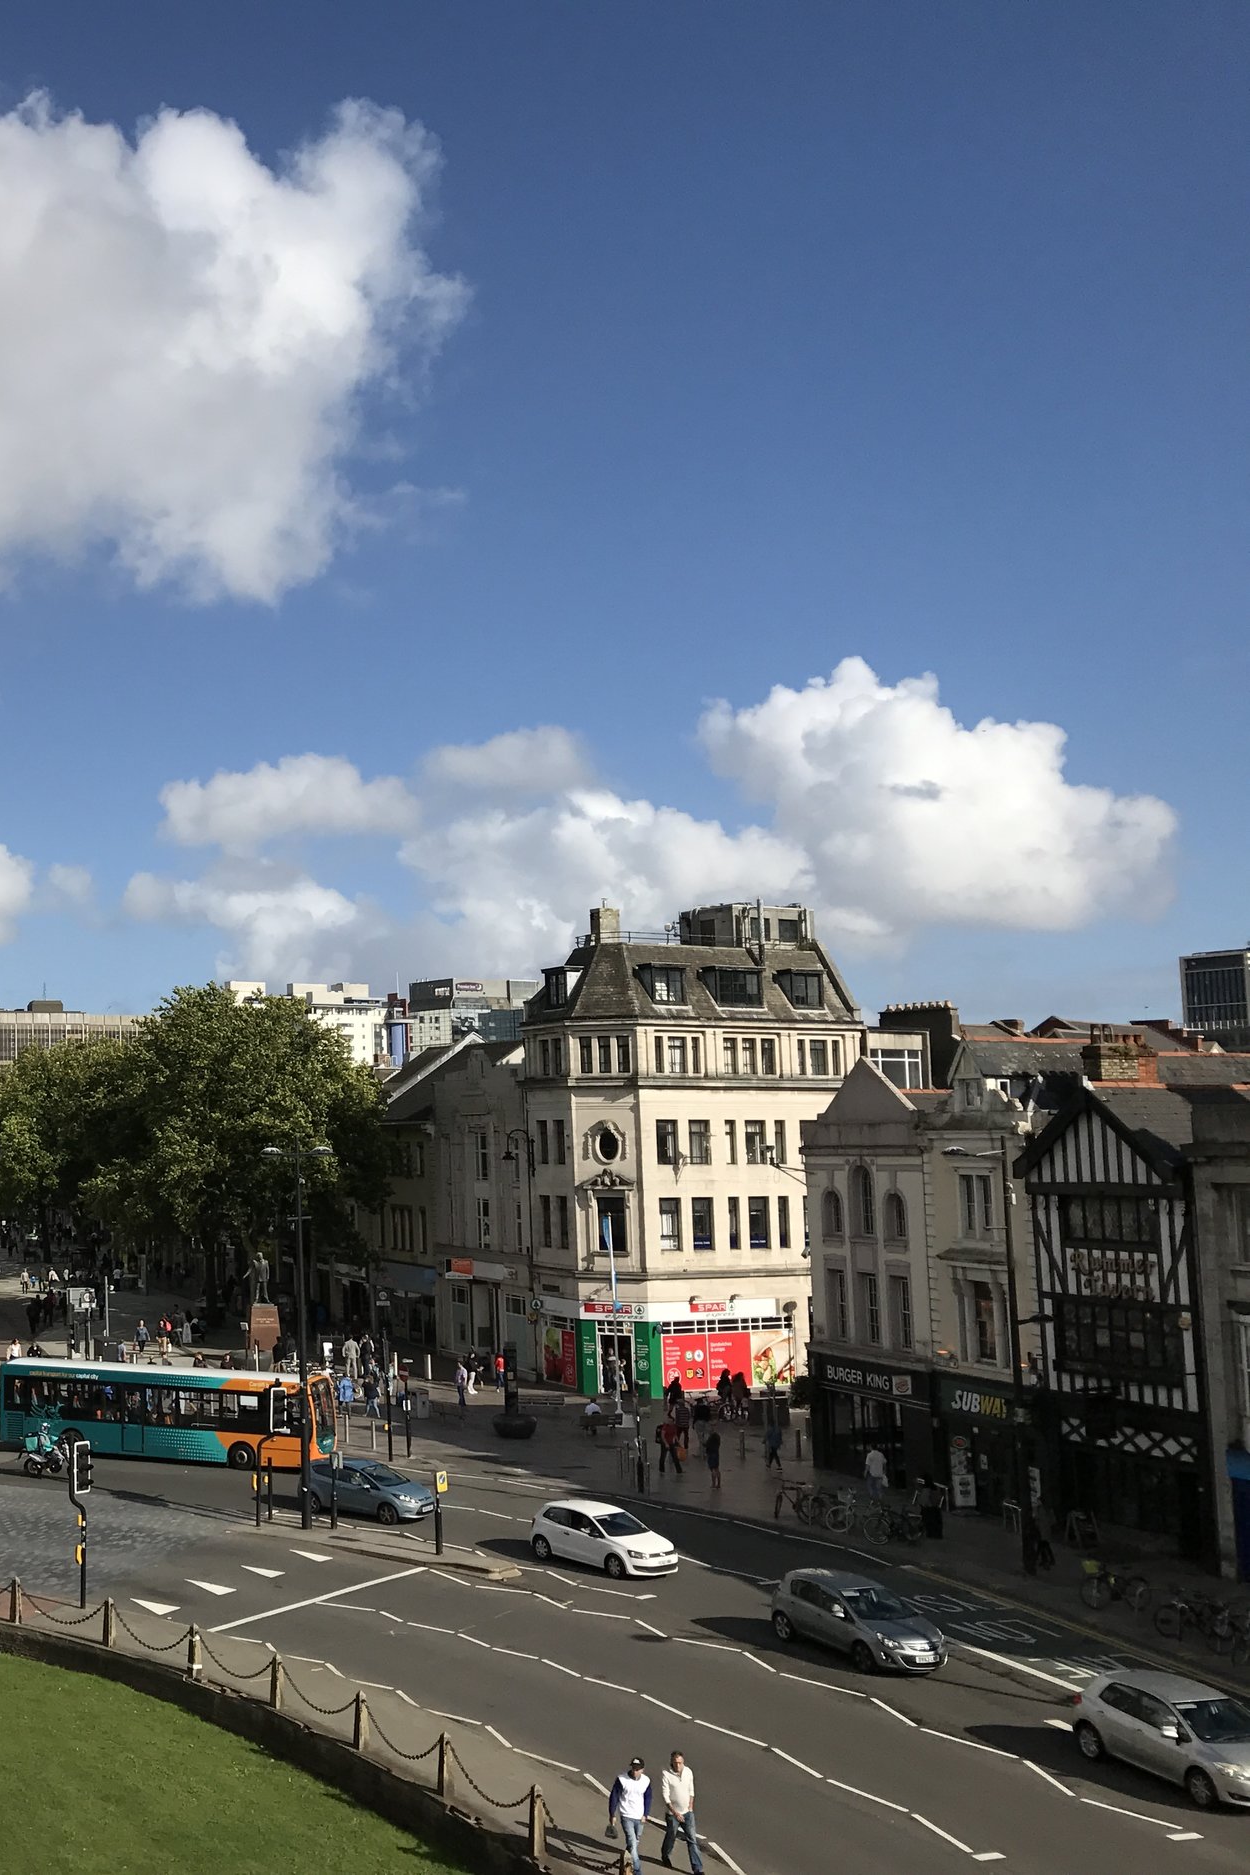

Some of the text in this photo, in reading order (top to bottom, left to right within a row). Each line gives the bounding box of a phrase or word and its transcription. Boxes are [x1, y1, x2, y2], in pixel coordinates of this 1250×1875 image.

[1070, 1251, 1156, 1275] Rummer
[1084, 1275, 1155, 1301] Tavern
[595, 1304, 631, 1312] SPR
[698, 1303, 726, 1311] SPAR
[827, 1365, 863, 1385] BURGER
[866, 1372, 890, 1390] KING
